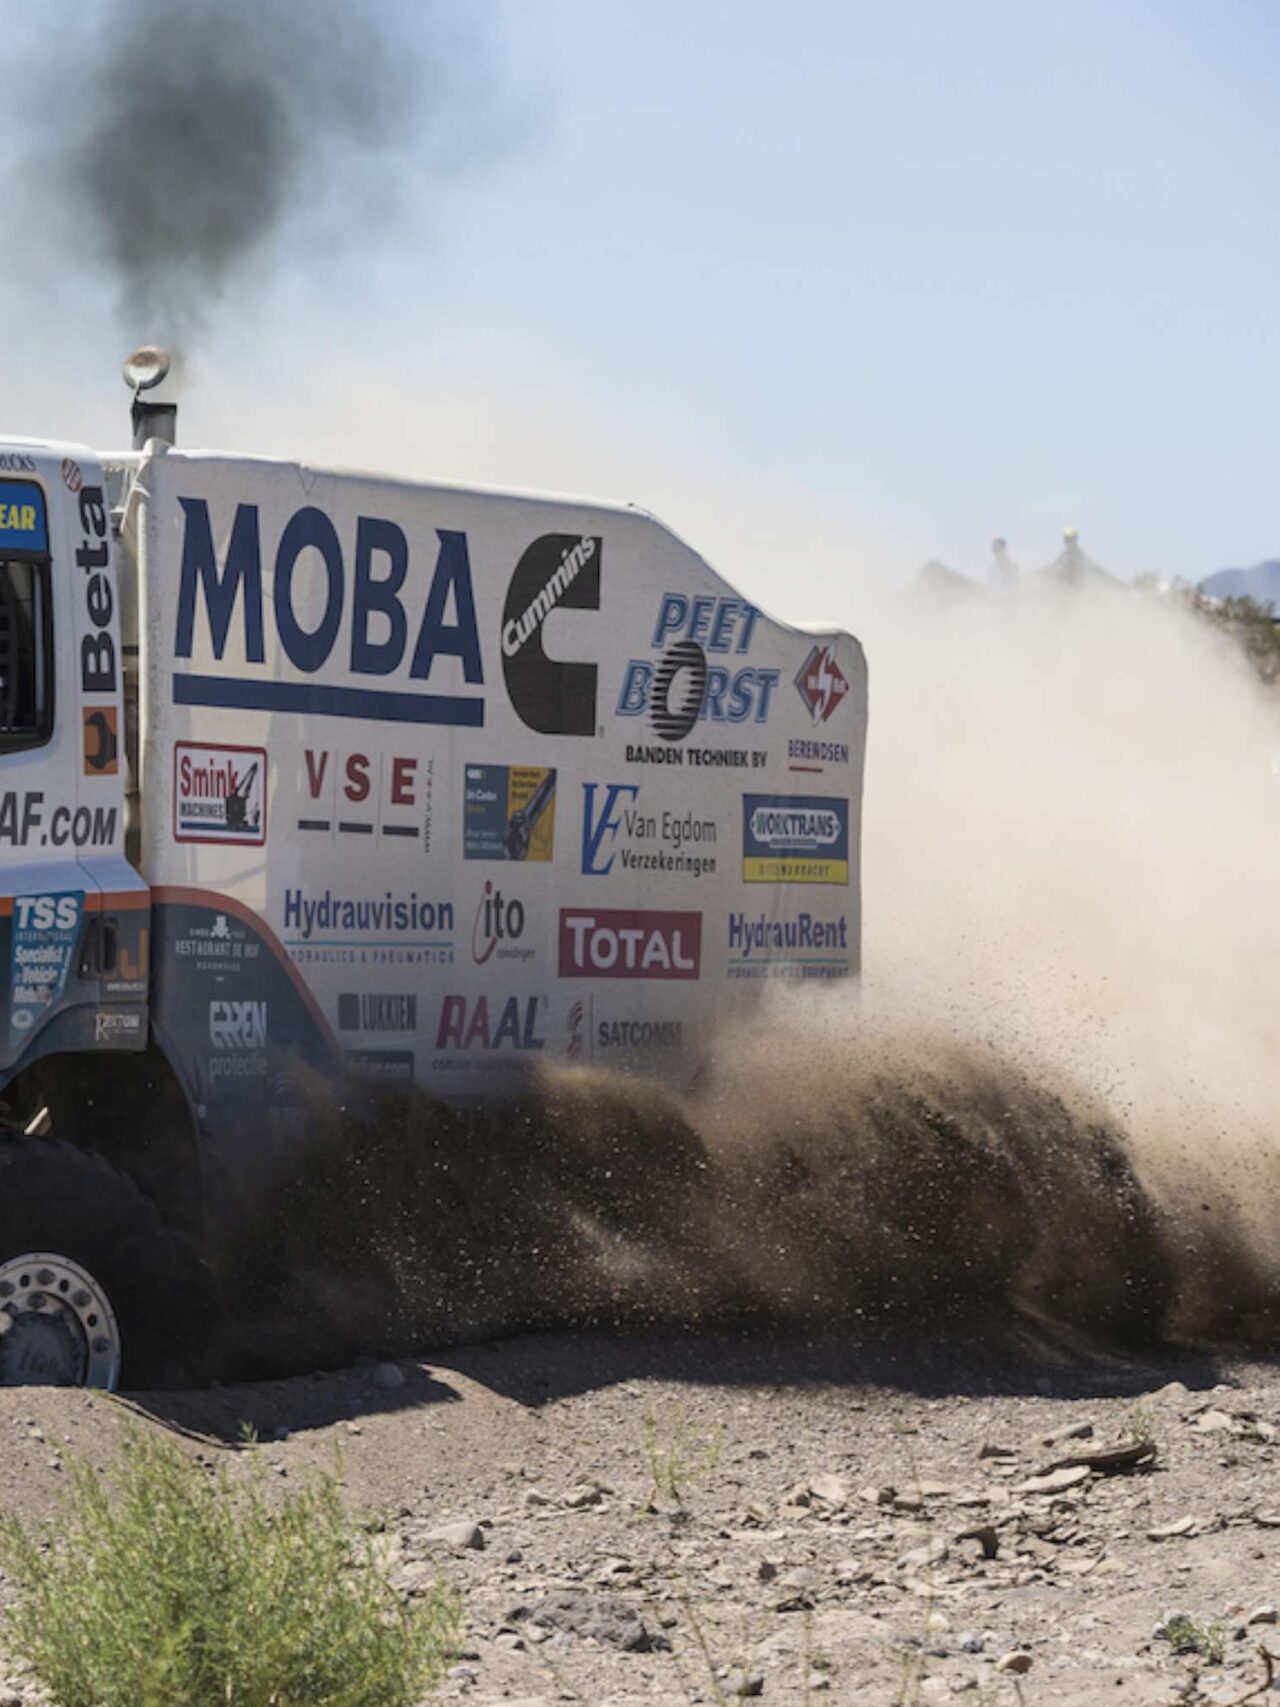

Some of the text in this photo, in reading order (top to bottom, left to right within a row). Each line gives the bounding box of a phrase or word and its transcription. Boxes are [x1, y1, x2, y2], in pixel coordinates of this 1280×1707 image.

[76, 486, 117, 692] Beta
[174, 496, 484, 685] MOBA
[501, 536, 595, 658] Cummins
[650, 592, 764, 654] PEET
[625, 745, 683, 765] BANDEN
[687, 749, 748, 768] TECHNIEK
[788, 739, 849, 763] BERENDSEN
[180, 755, 238, 800] Smink
[624, 810, 717, 848] Van Egdom
[755, 813, 834, 838] WORKTRANS
[621, 849, 717, 877] Verzekeringen
[17, 897, 78, 929] TSS
[284, 889, 454, 939] Hydrauvision
[729, 913, 847, 957] HydrauRent
[565, 917, 694, 970] TOTAL
[436, 994, 545, 1050] RAAL
